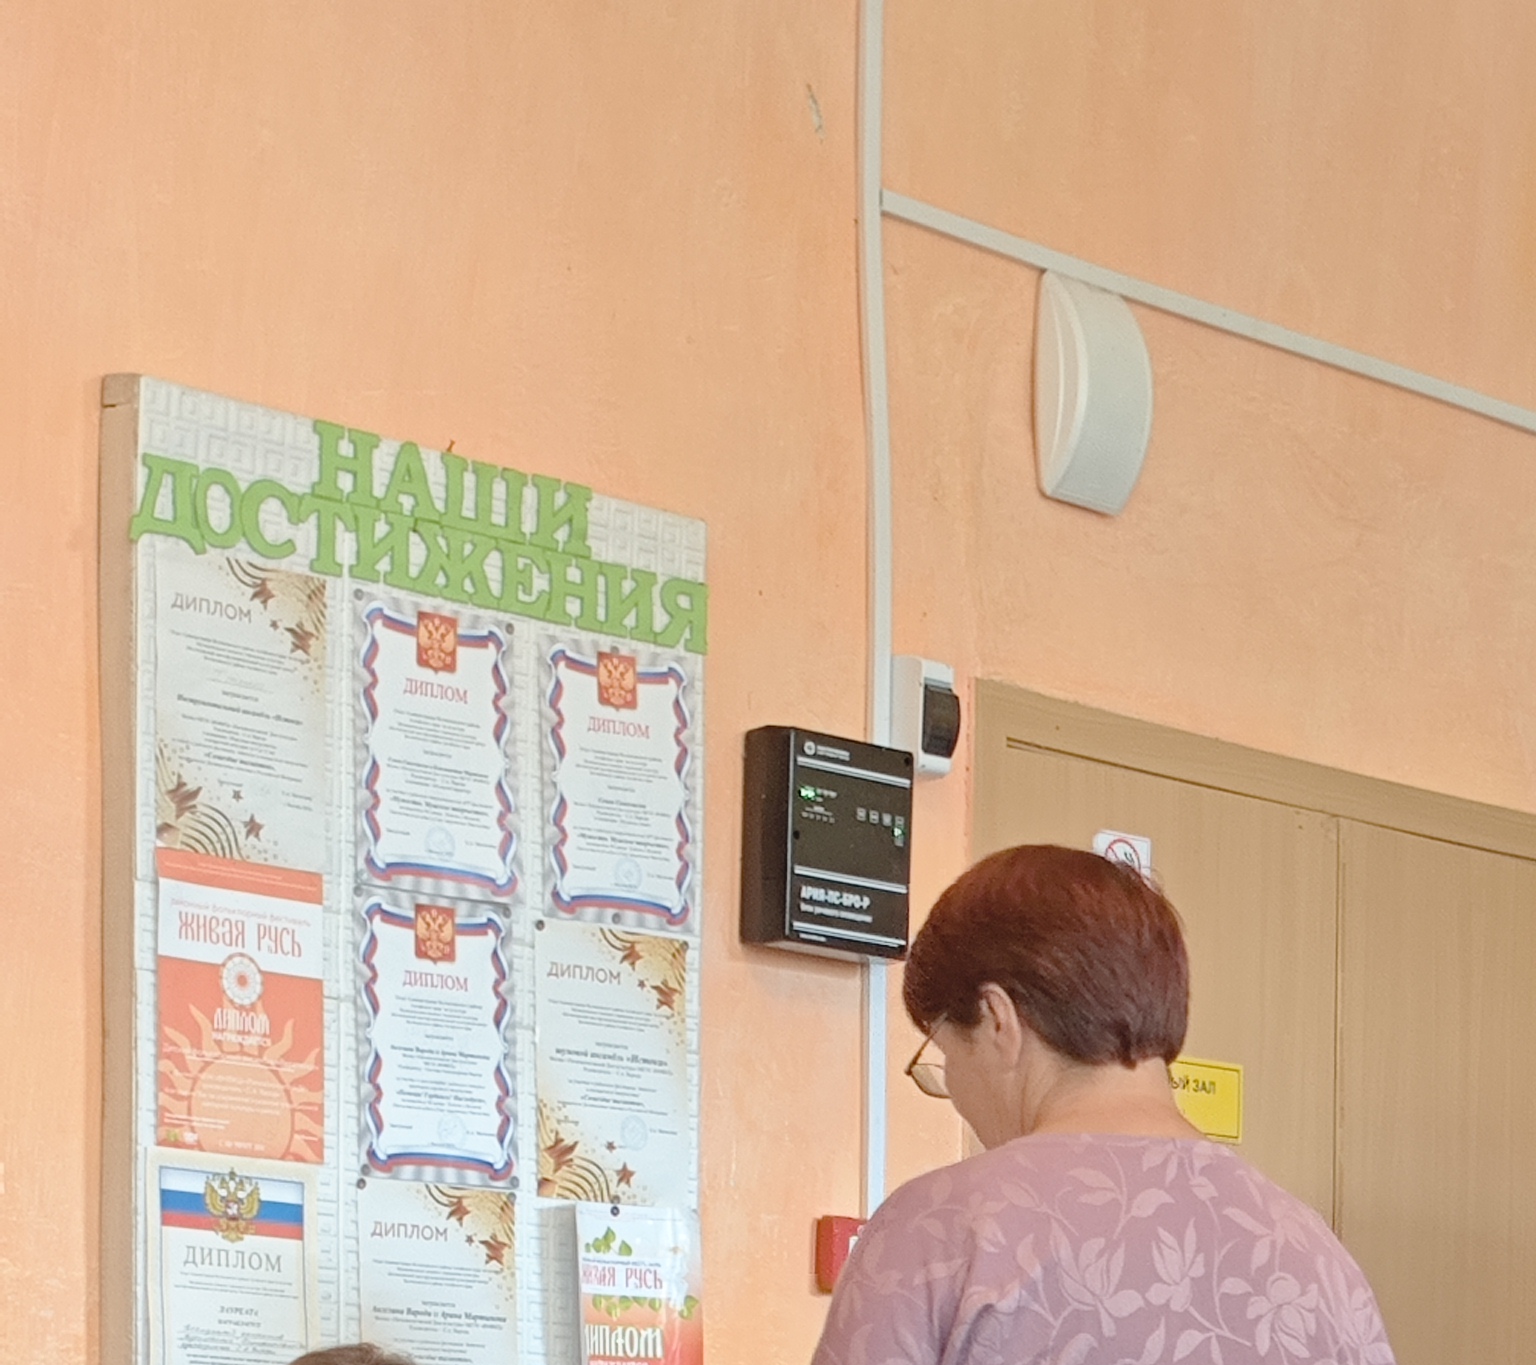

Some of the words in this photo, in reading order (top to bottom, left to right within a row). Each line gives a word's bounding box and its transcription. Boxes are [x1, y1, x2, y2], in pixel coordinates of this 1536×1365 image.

[312, 420, 593, 557] НАШИ
[130, 452, 709, 656] ДОСТИЖЕНИЯ
[171, 592, 252, 624] ДИПЛОМ
[403, 677, 469, 705] ДИПЛОМ
[587, 716, 650, 739] ДИПЛОМ
[178, 911, 246, 949] ЖИВАЯ
[257, 922, 303, 958] РУСЬ
[402, 970, 469, 992] ДИПЛОМ
[547, 962, 621, 985] ДИПЛОМ
[213, 1007, 271, 1036] ДИПЛОМ
[1192, 1078, 1216, 1095] ЗАЛ
[370, 1221, 449, 1242] ДИПЛОМ
[183, 1245, 283, 1273] ДИПЛОМ
[625, 1267, 664, 1290] РУСЬ
